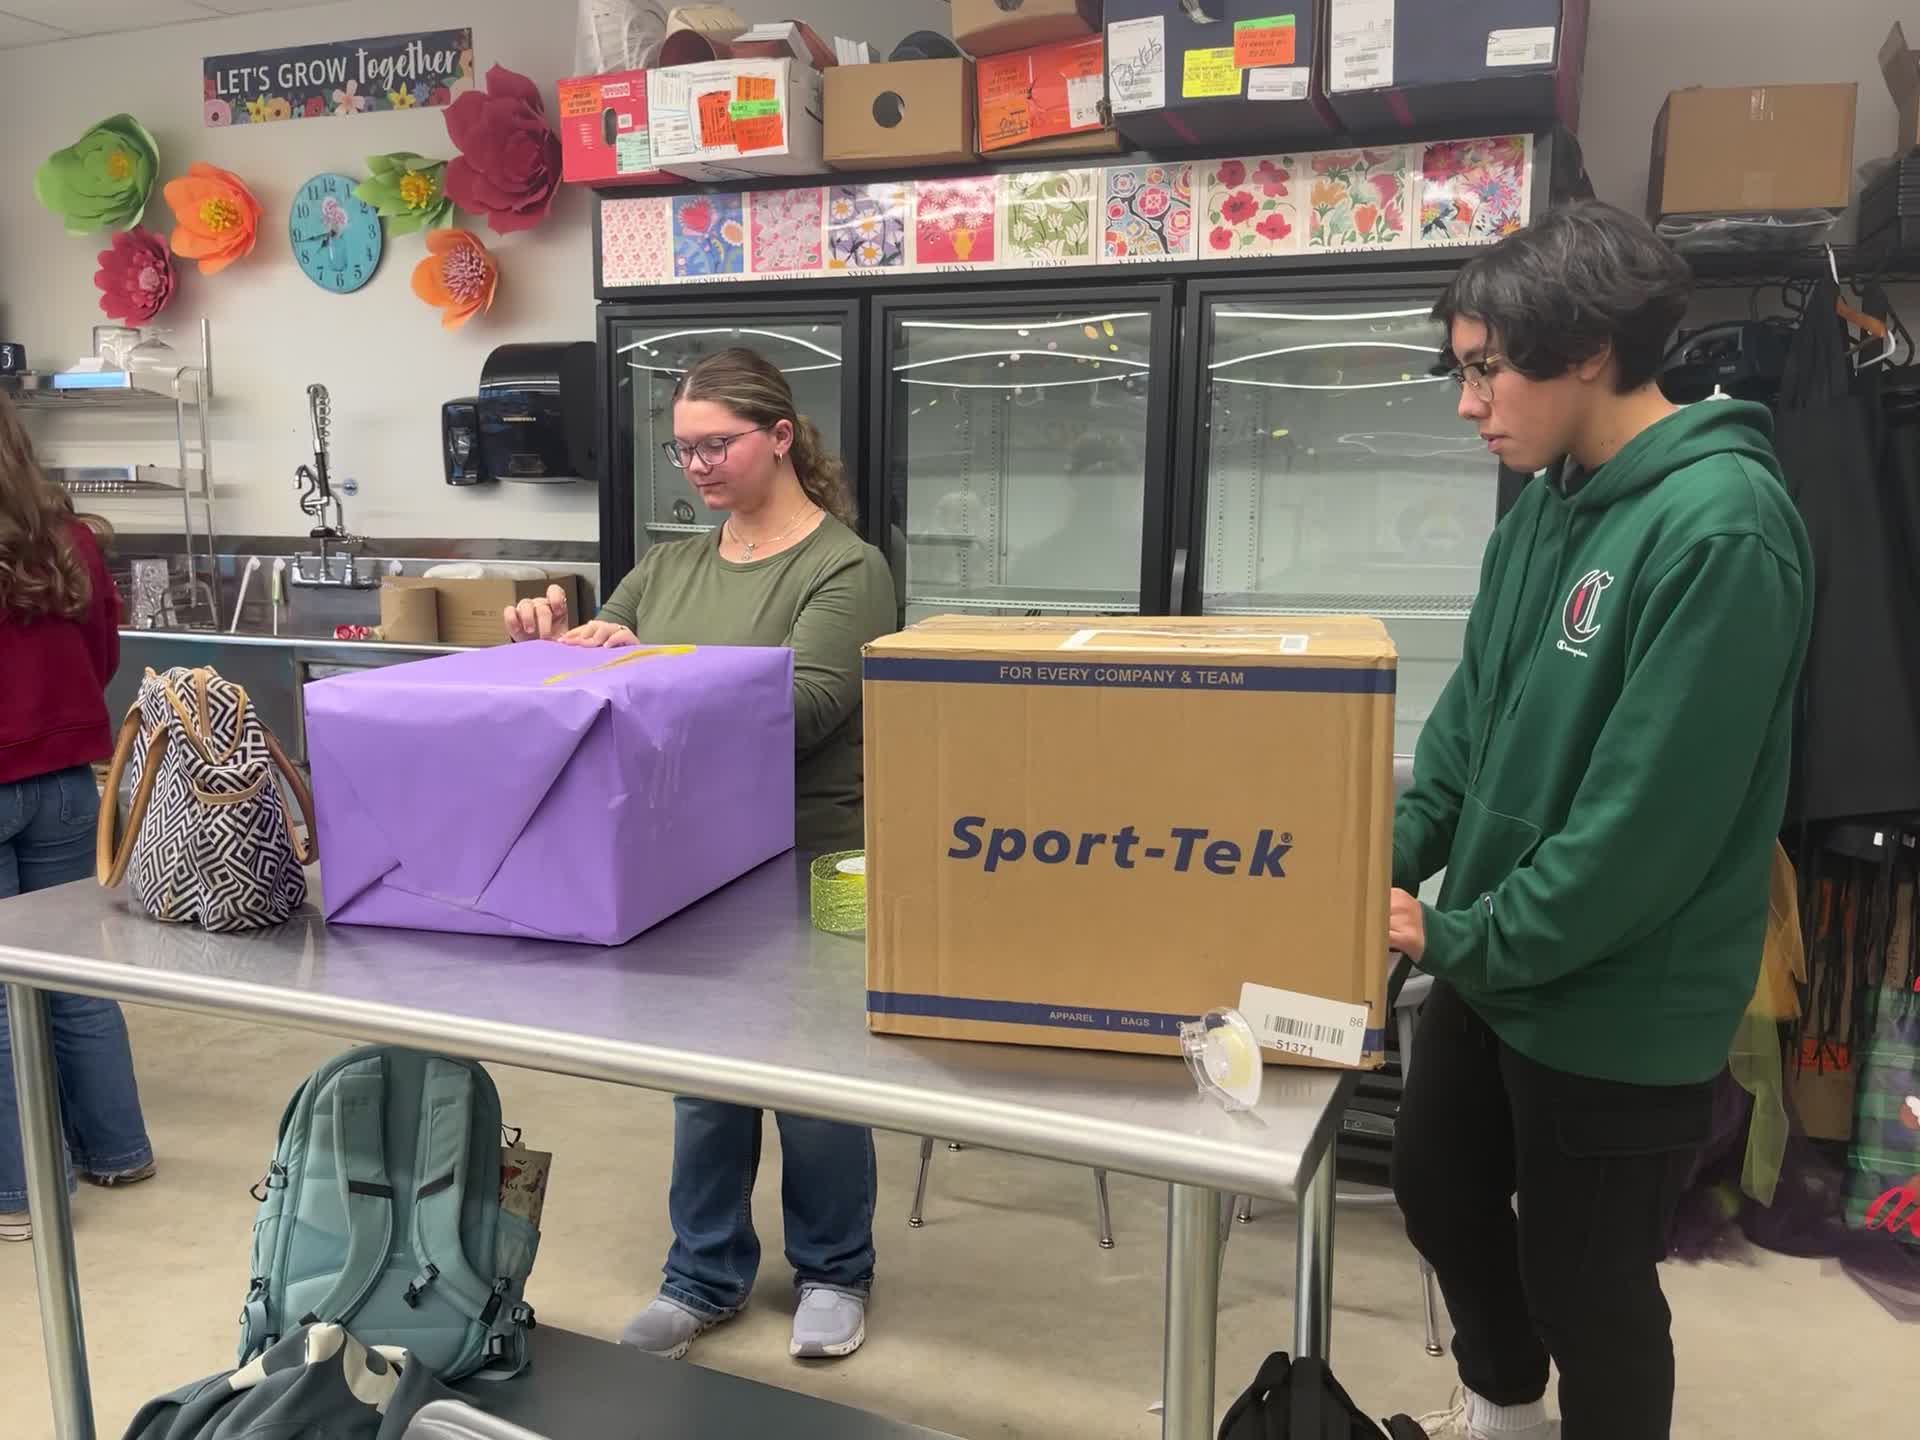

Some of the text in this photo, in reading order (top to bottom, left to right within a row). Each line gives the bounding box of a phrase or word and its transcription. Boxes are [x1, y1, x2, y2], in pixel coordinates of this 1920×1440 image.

[216, 66, 270, 95] LET'S
[278, 57, 347, 88] GROW
[308, 185, 319, 200] 11
[323, 178, 336, 193] 12
[297, 204, 310, 219] 10
[368, 223, 377, 240] 3
[301, 250, 310, 264] 8
[1031, 258, 1068, 268] TOKYO
[316, 265, 324, 281] 7
[354, 264, 362, 280] 5
[336, 272, 345, 289] 6
[1000, 666, 1245, 685] FOR EVERY COMPANY & TEAM
[1049, 1011, 1150, 1027] APPAREL BAGS
[1349, 1017, 1364, 1028] 86
[1276, 1039, 1314, 1057] 51371
